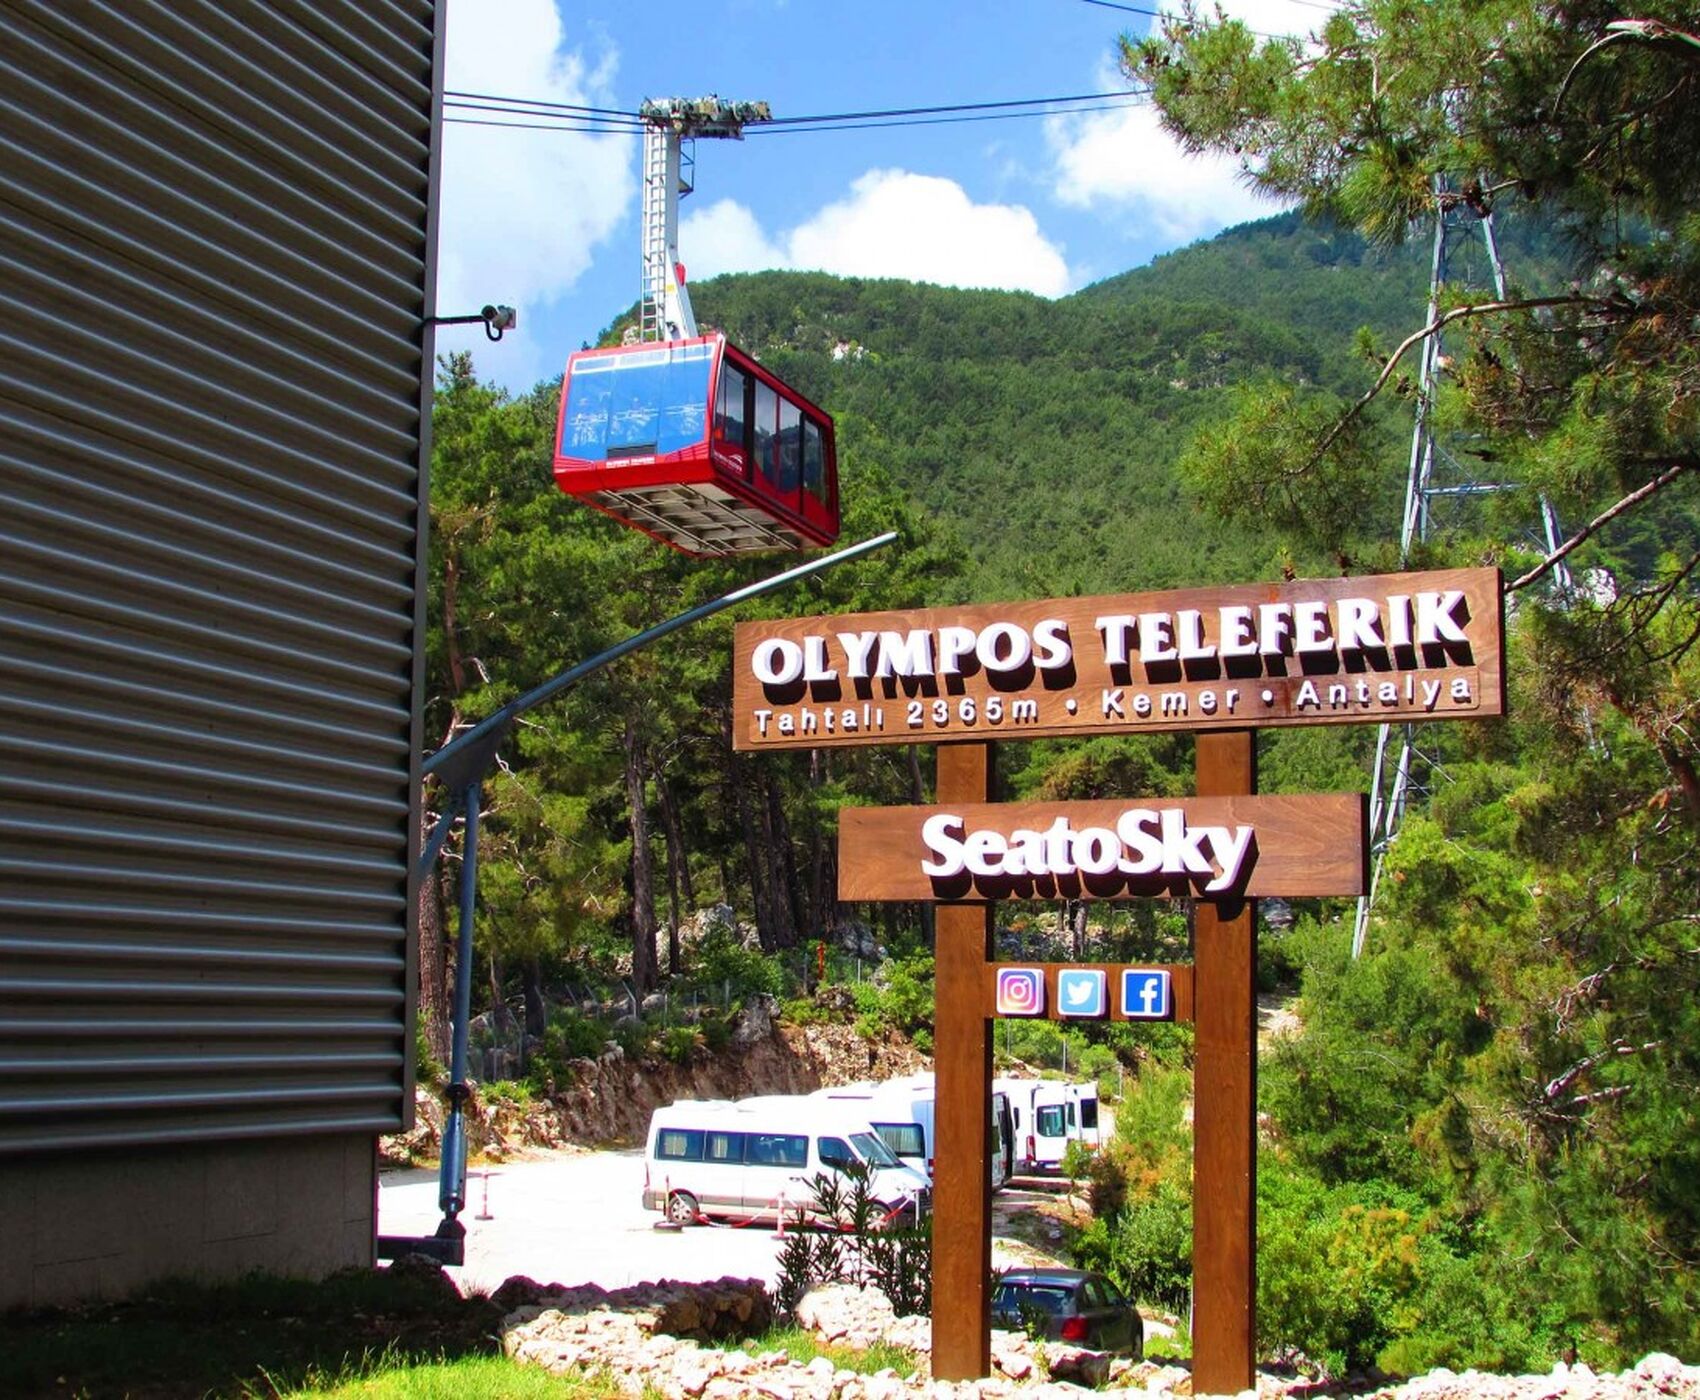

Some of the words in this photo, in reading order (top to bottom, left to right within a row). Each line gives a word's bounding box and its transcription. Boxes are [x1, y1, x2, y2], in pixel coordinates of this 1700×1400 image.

[751, 619, 1074, 685] OLYMPOS
[1095, 590, 1470, 664] TELEFERIK
[754, 703, 883, 733] Tahtalı
[906, 696, 1038, 726] 2365m
[1102, 687, 1240, 715] Kemer
[1296, 674, 1472, 708] Antalya
[921, 808, 1255, 892] SeatoSky
